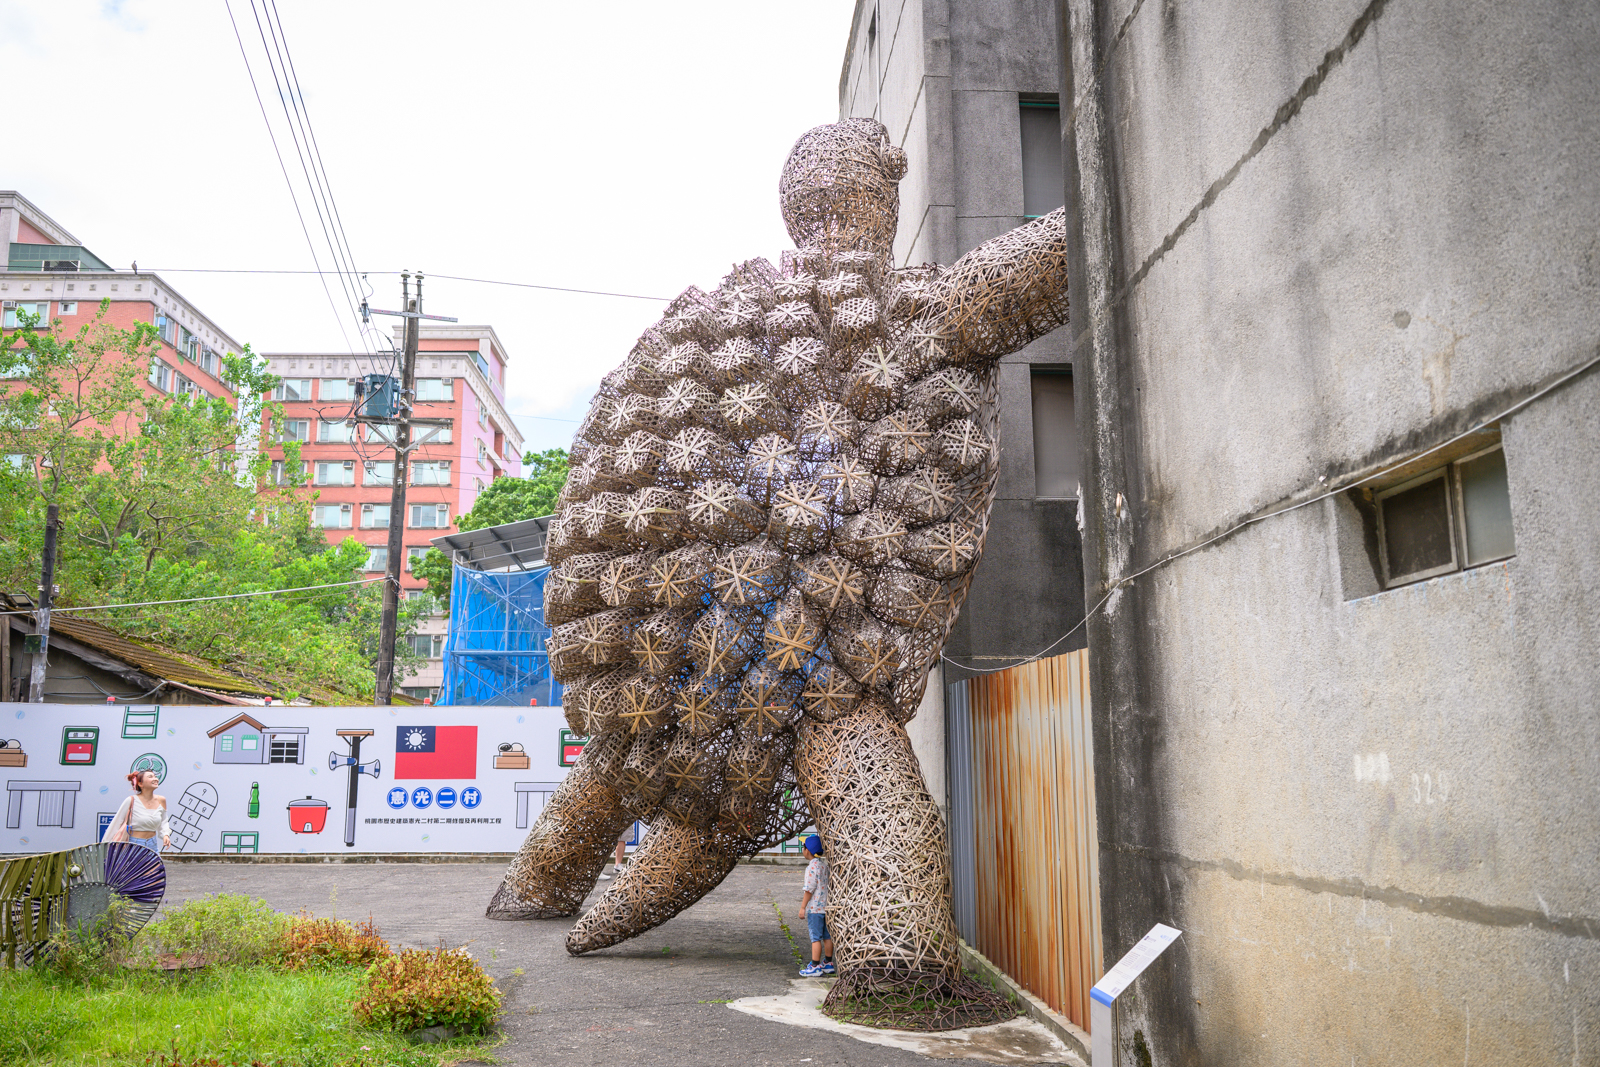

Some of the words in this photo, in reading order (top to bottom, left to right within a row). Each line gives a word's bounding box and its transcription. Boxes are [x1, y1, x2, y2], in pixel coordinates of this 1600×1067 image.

[202, 788, 207, 796] 9
[390, 789, 479, 805] 憲光二村
